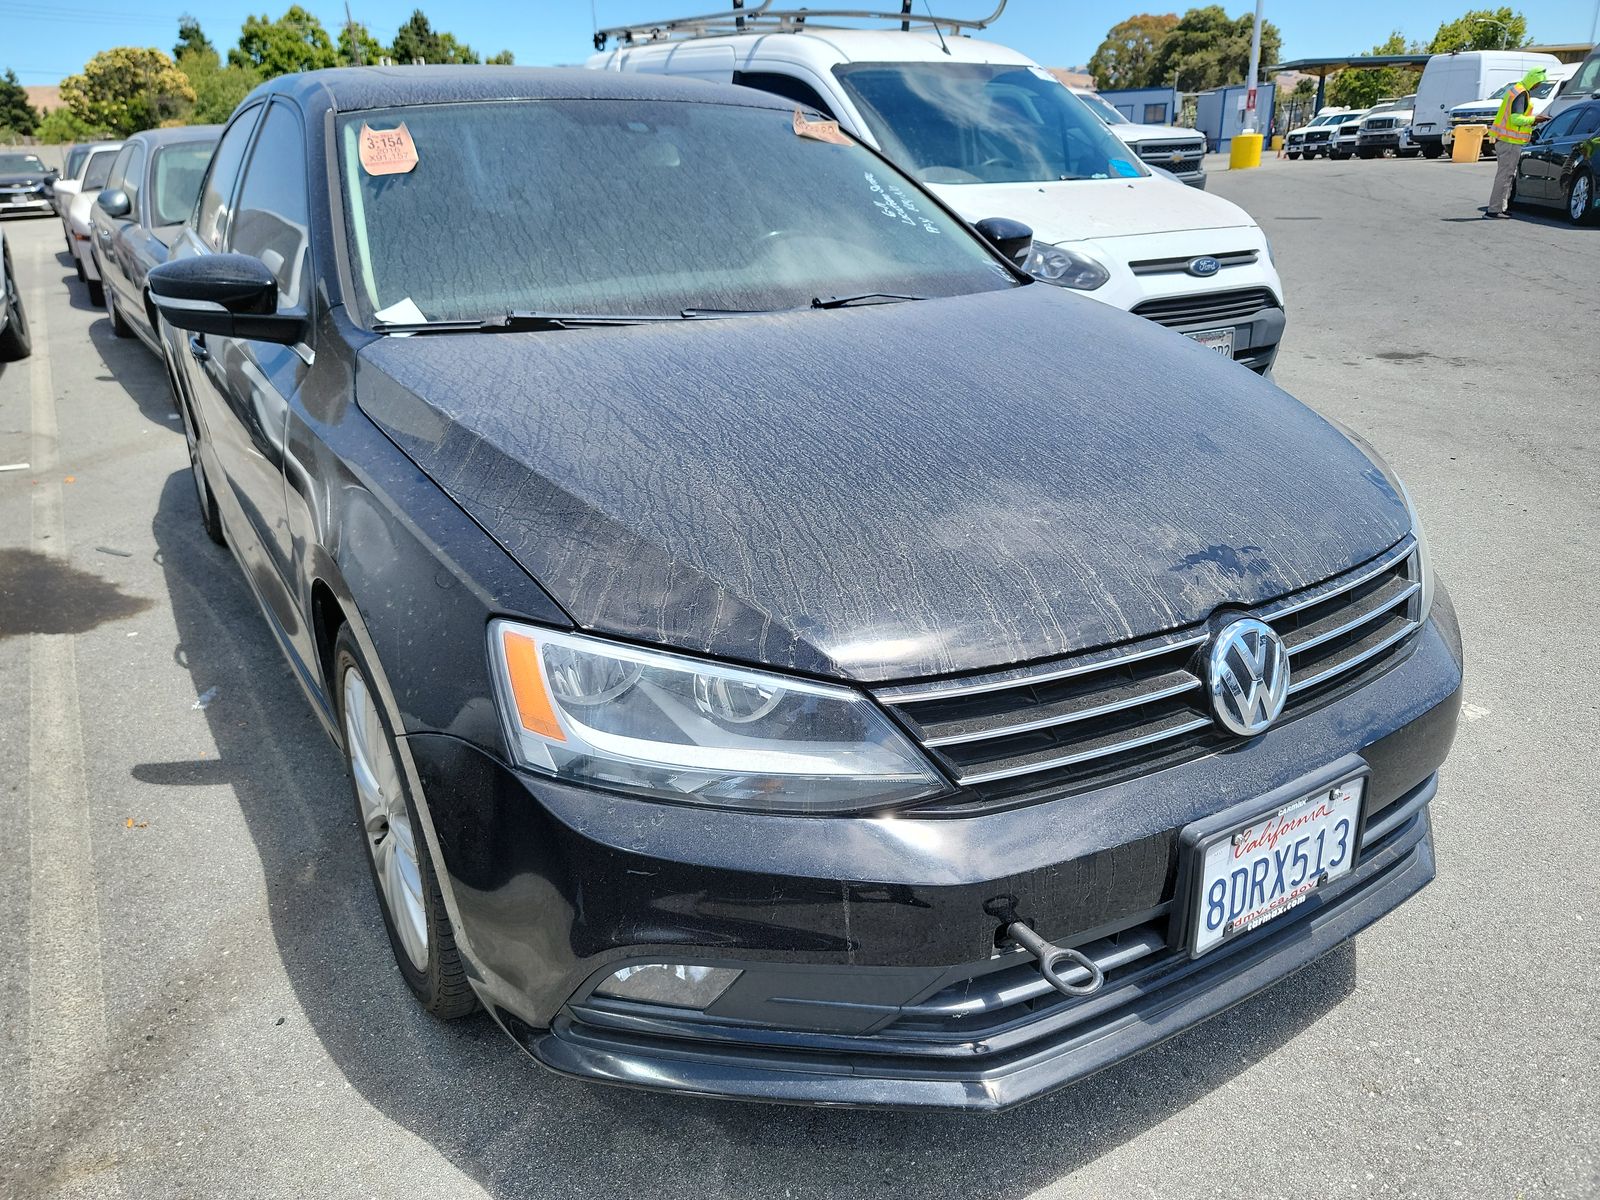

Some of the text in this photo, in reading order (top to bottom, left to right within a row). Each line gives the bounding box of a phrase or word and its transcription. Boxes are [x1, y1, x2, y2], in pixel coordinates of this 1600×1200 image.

[1199, 260, 1216, 271] Ford
[1234, 801, 1335, 859] California
[1206, 818, 1350, 931] 8DRX513
[1234, 880, 1316, 927] dmv.ca.gov
[1247, 894, 1306, 931] carmax.com
